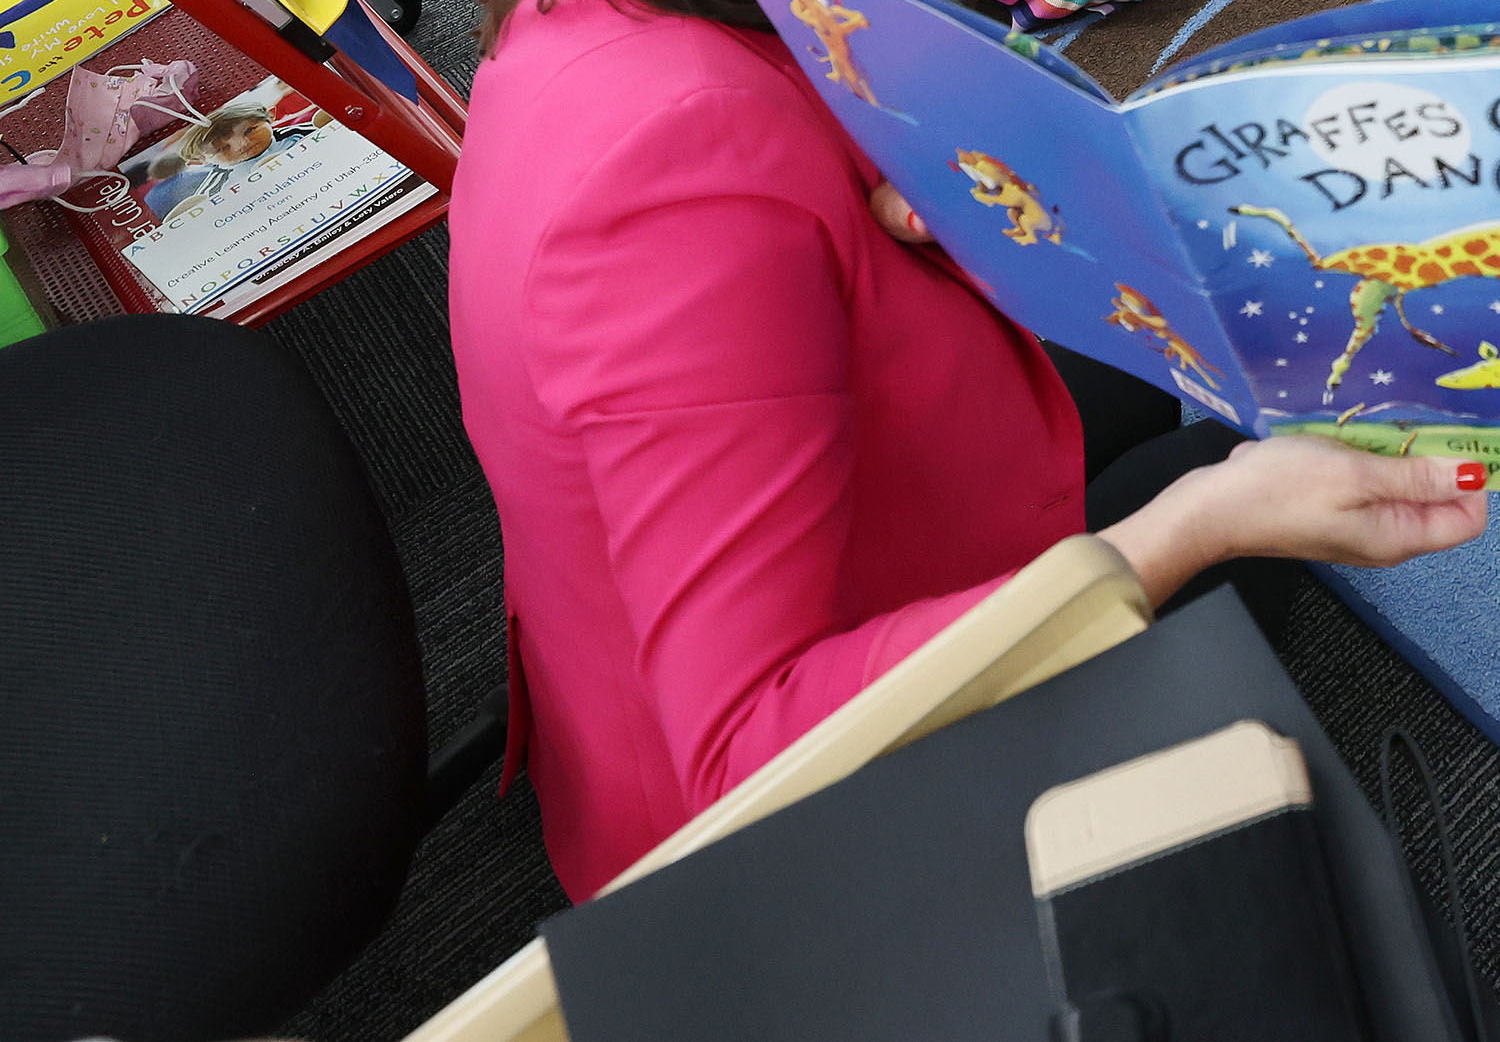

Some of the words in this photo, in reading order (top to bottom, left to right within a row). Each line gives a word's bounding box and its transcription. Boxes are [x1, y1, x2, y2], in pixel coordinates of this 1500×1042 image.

[68, 6, 107, 34] Love
[31, 38, 63, 60] My
[38, 55, 64, 74] the
[0, 69, 31, 91] C
[1175, 101, 1462, 185] GIRAFFES
[96, 180, 143, 227] Guide
[131, 245, 145, 256] A
[150, 231, 163, 242] B
[168, 218, 184, 229] C
[188, 208, 204, 218] D
[209, 195, 224, 206] E
[230, 183, 241, 194] F
[248, 171, 263, 183] G
[267, 160, 283, 172] H
[300, 144, 307, 153] J
[312, 131, 327, 143] K
[213, 160, 323, 229] Congratulations
[266, 194, 293, 211] from
[167, 255, 215, 288] Creative
[217, 223, 267, 258] Learning
[268, 190, 319, 227] Academy
[181, 293, 197, 307] N
[201, 281, 217, 293] O
[219, 270, 232, 281] P
[259, 247, 275, 257] R
[277, 235, 291, 245] S
[292, 224, 307, 235] T
[311, 213, 326, 224] U
[329, 200, 344, 210] V
[349, 184, 368, 198] W
[371, 173, 388, 184] X
[313, 225, 343, 248] Bailey
[343, 220, 352, 229] &
[352, 206, 374, 224] Lety
[372, 188, 404, 211] Valero
[1447, 439, 1500, 455] Giles
